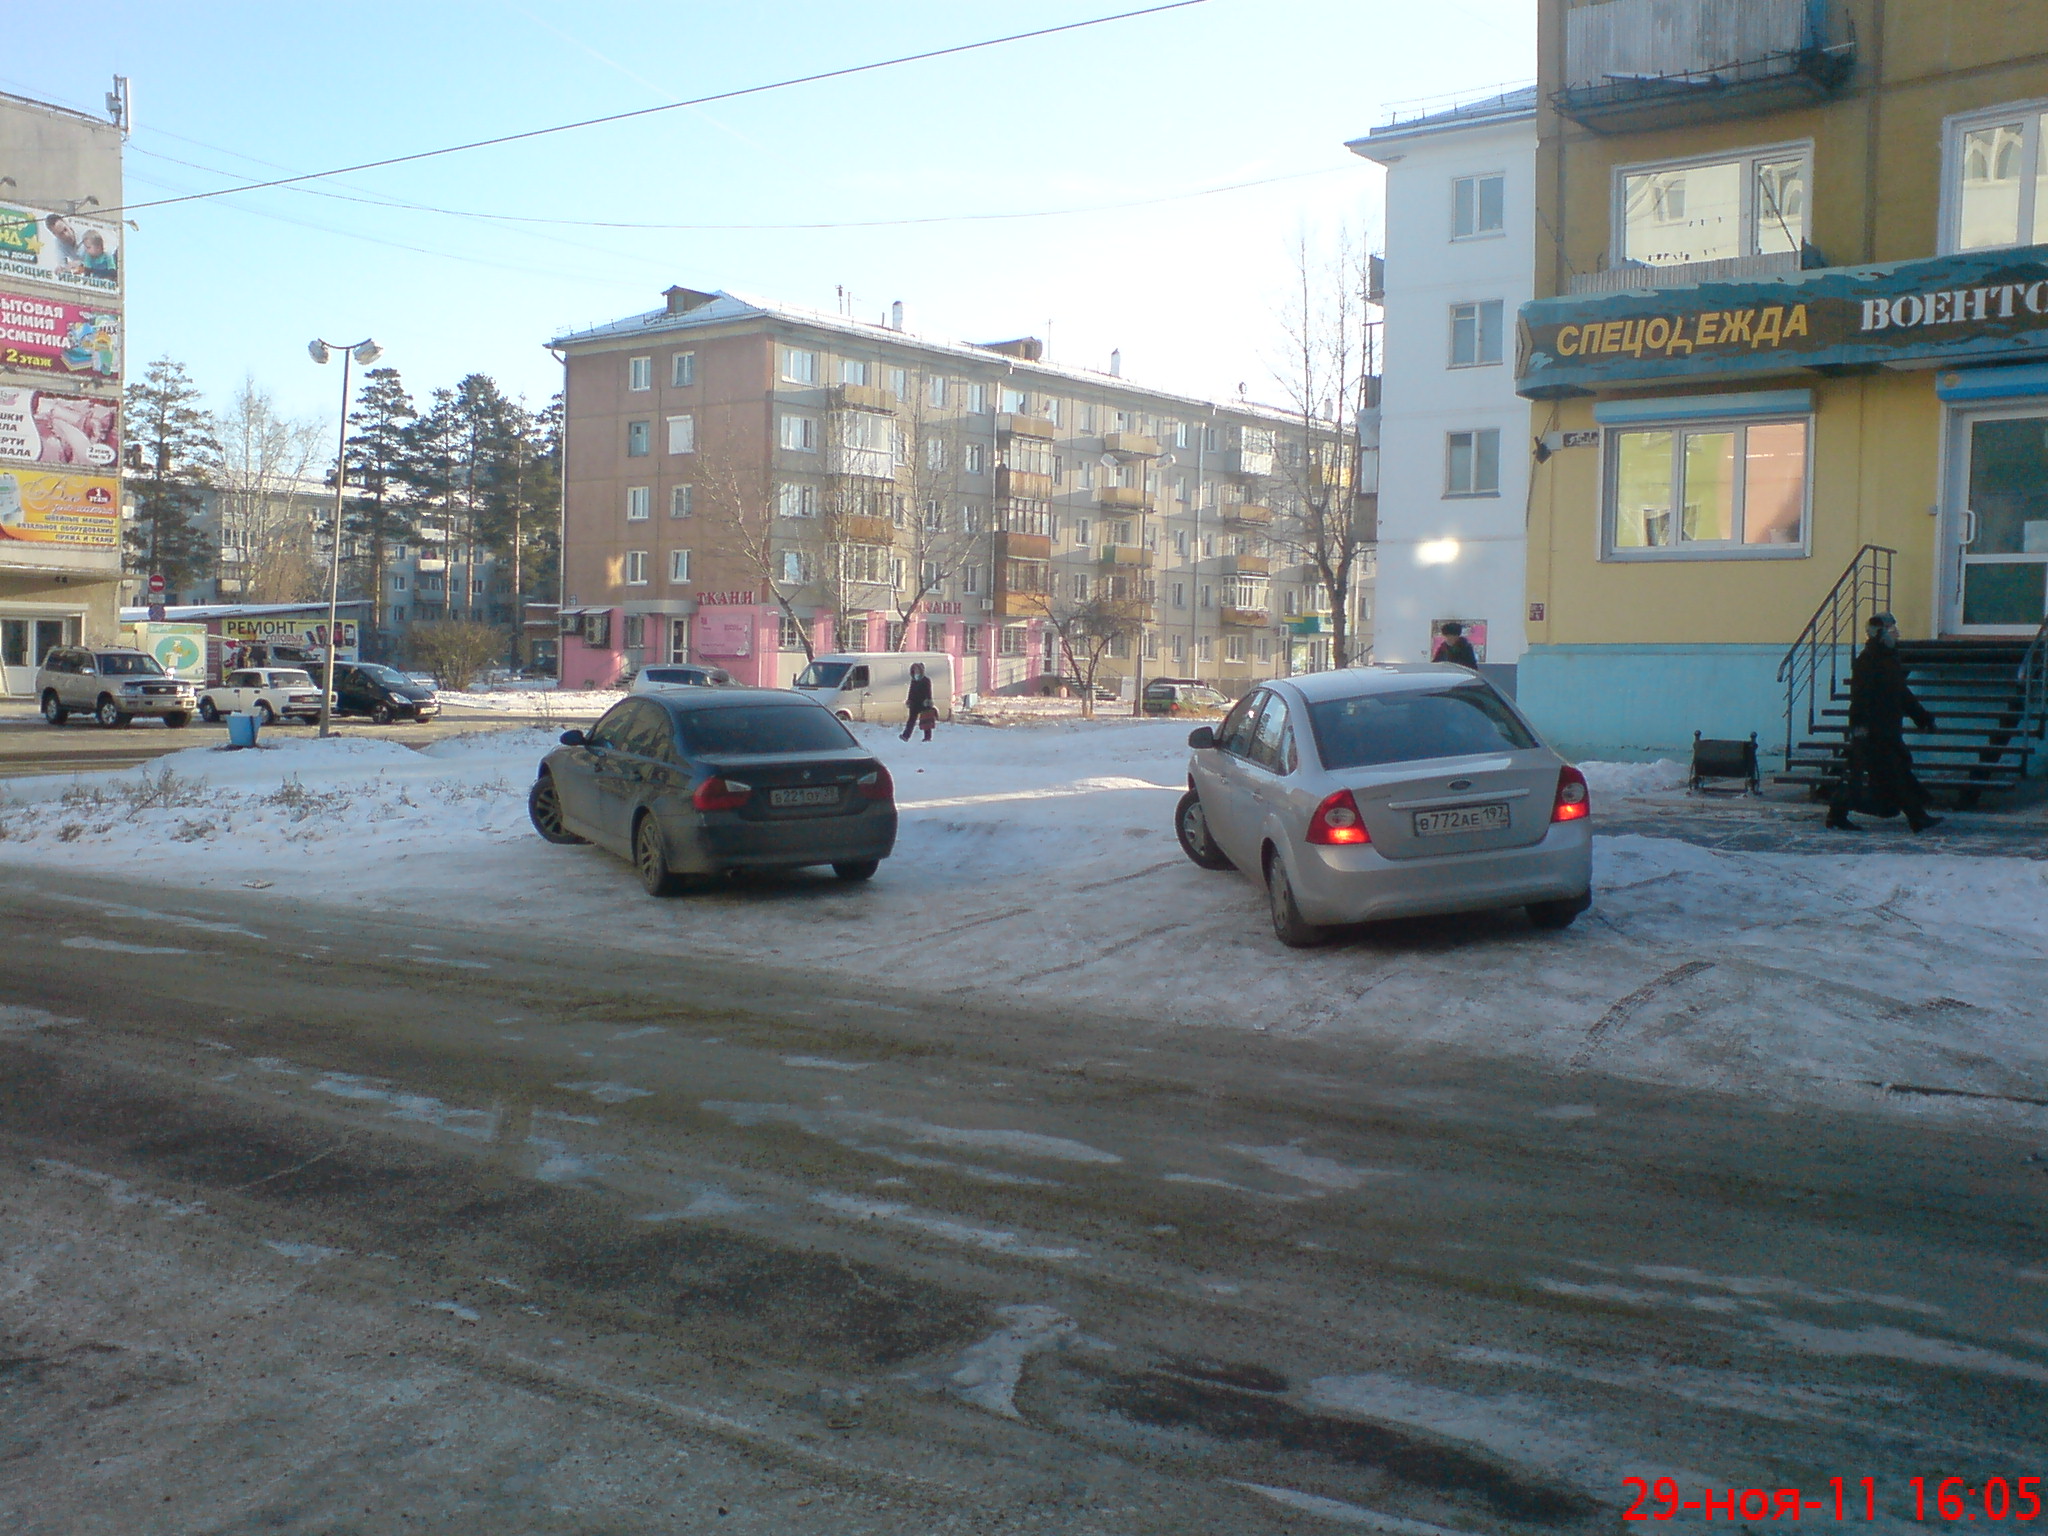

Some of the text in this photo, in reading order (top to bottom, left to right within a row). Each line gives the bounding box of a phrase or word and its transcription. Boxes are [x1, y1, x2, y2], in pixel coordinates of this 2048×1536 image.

[58, 272, 116, 290] ИГРУШКИ
[0, 298, 64, 319] ЫТОВАЯ
[1, 311, 54, 331] ХИМИЯ
[1556, 304, 1808, 358] СПЕЦОДЕЖДА
[6, 348, 52, 367] 2 этаж
[697, 591, 755, 605] ТКАНИ
[228, 621, 297, 635] РЕМОНТ
[1420, 806, 1504, 830] В772АЕ 197
